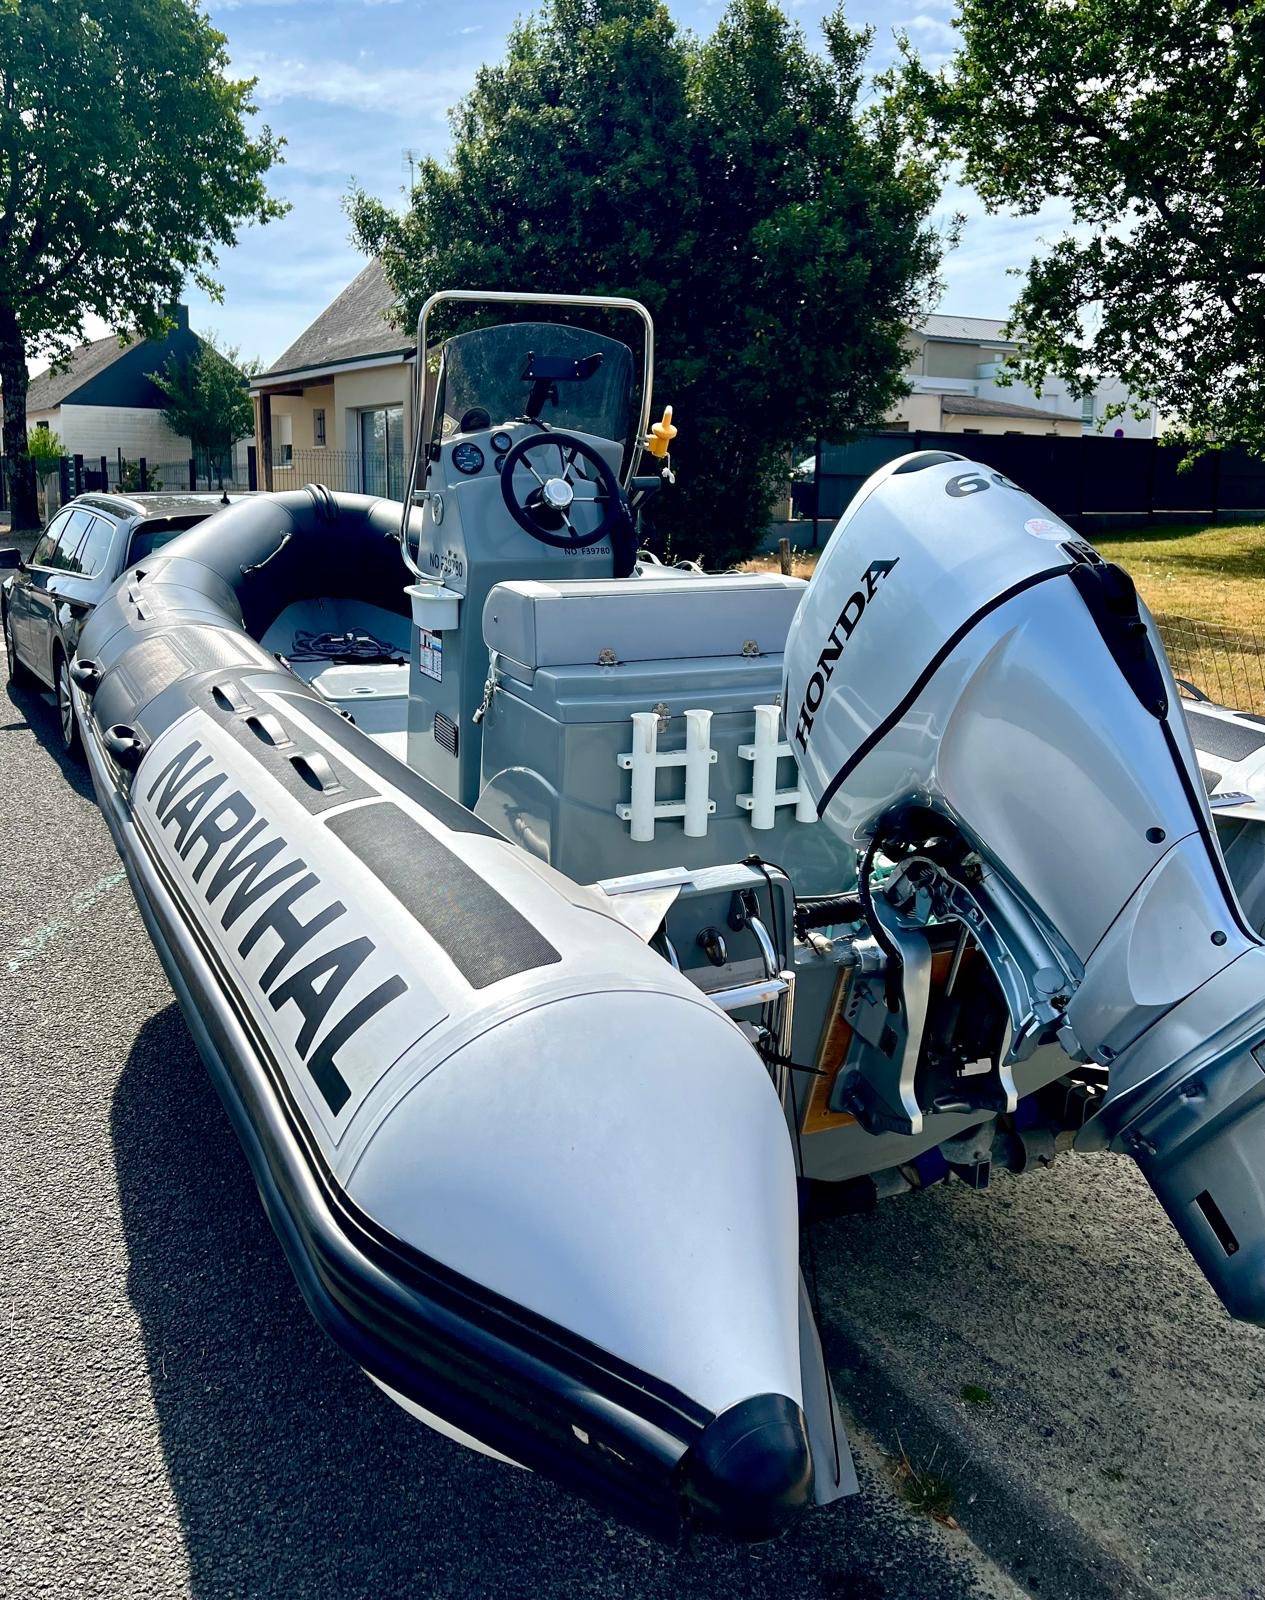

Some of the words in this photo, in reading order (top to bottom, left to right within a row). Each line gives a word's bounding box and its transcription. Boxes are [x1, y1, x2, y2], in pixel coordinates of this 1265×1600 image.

[430, 552, 440, 569] NO
[581, 547, 610, 555] F39780
[795, 556, 900, 755] HONDA
[146, 739, 409, 1118] NARWHAL
